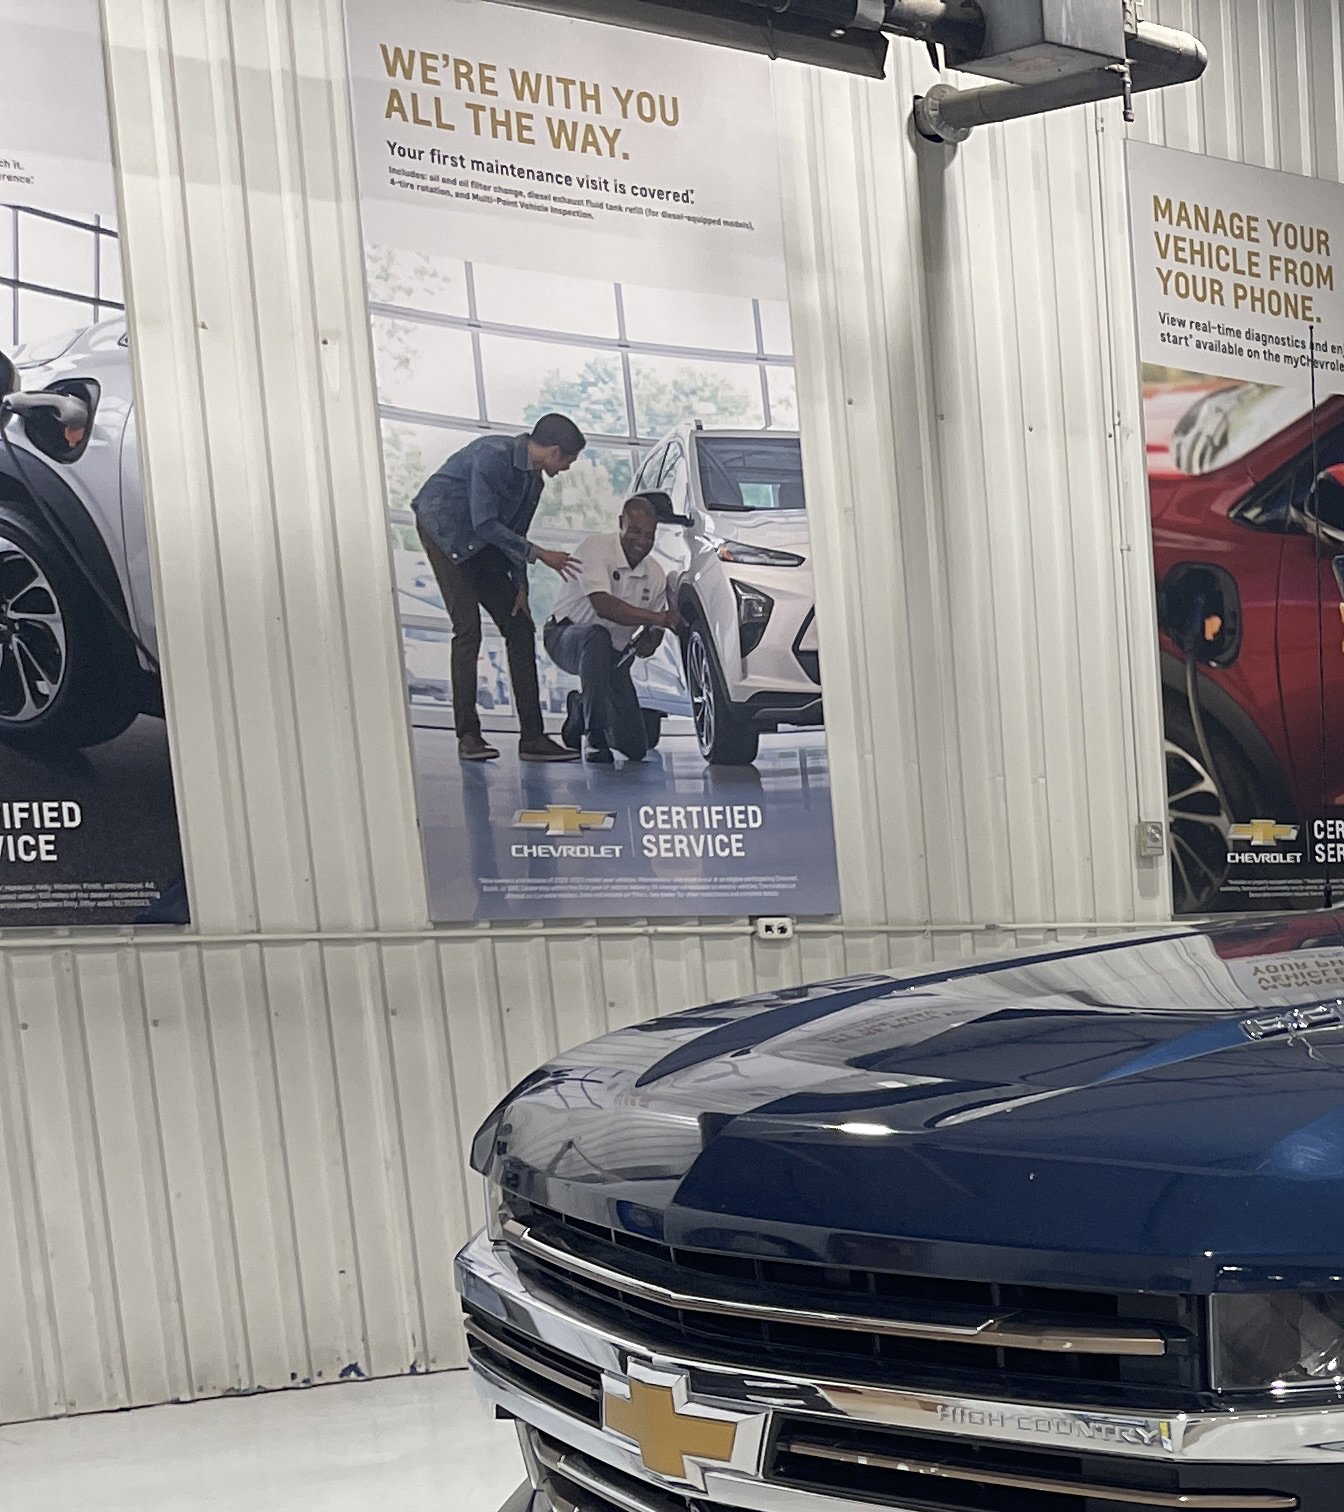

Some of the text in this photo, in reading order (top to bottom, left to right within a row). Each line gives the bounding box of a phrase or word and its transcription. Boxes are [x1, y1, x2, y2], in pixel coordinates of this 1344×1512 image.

[379, 43, 680, 127] WE'RE WITH YOU
[384, 88, 631, 161] ALL THE WAY.
[386, 139, 425, 162] Your
[430, 149, 467, 170] first
[470, 158, 573, 187] maintenance
[575, 174, 610, 193] visit
[613, 179, 627, 196] is
[1152, 194, 1331, 257] MANAGE YOUR
[1153, 230, 1334, 291] VEHICLE FROM
[1155, 266, 1322, 324] YOUR PHONE.
[1158, 311, 1187, 329] View
[1188, 318, 1242, 340] real-time
[1244, 328, 1306, 351] diagnostics
[1308, 339, 1329, 354] and
[1195, 337, 1245, 358] available
[1246, 348, 1261, 360] on
[1262, 348, 1282, 364] the
[2, 801, 82, 829] IFIED
[638, 805, 763, 830] CERTIFIED
[510, 844, 624, 858] CHEVROLET
[642, 833, 746, 858] SERVICE
[1226, 852, 1303, 864] CHEVROLET
[936, 1404, 1159, 1446] HIGH COUNTRY
